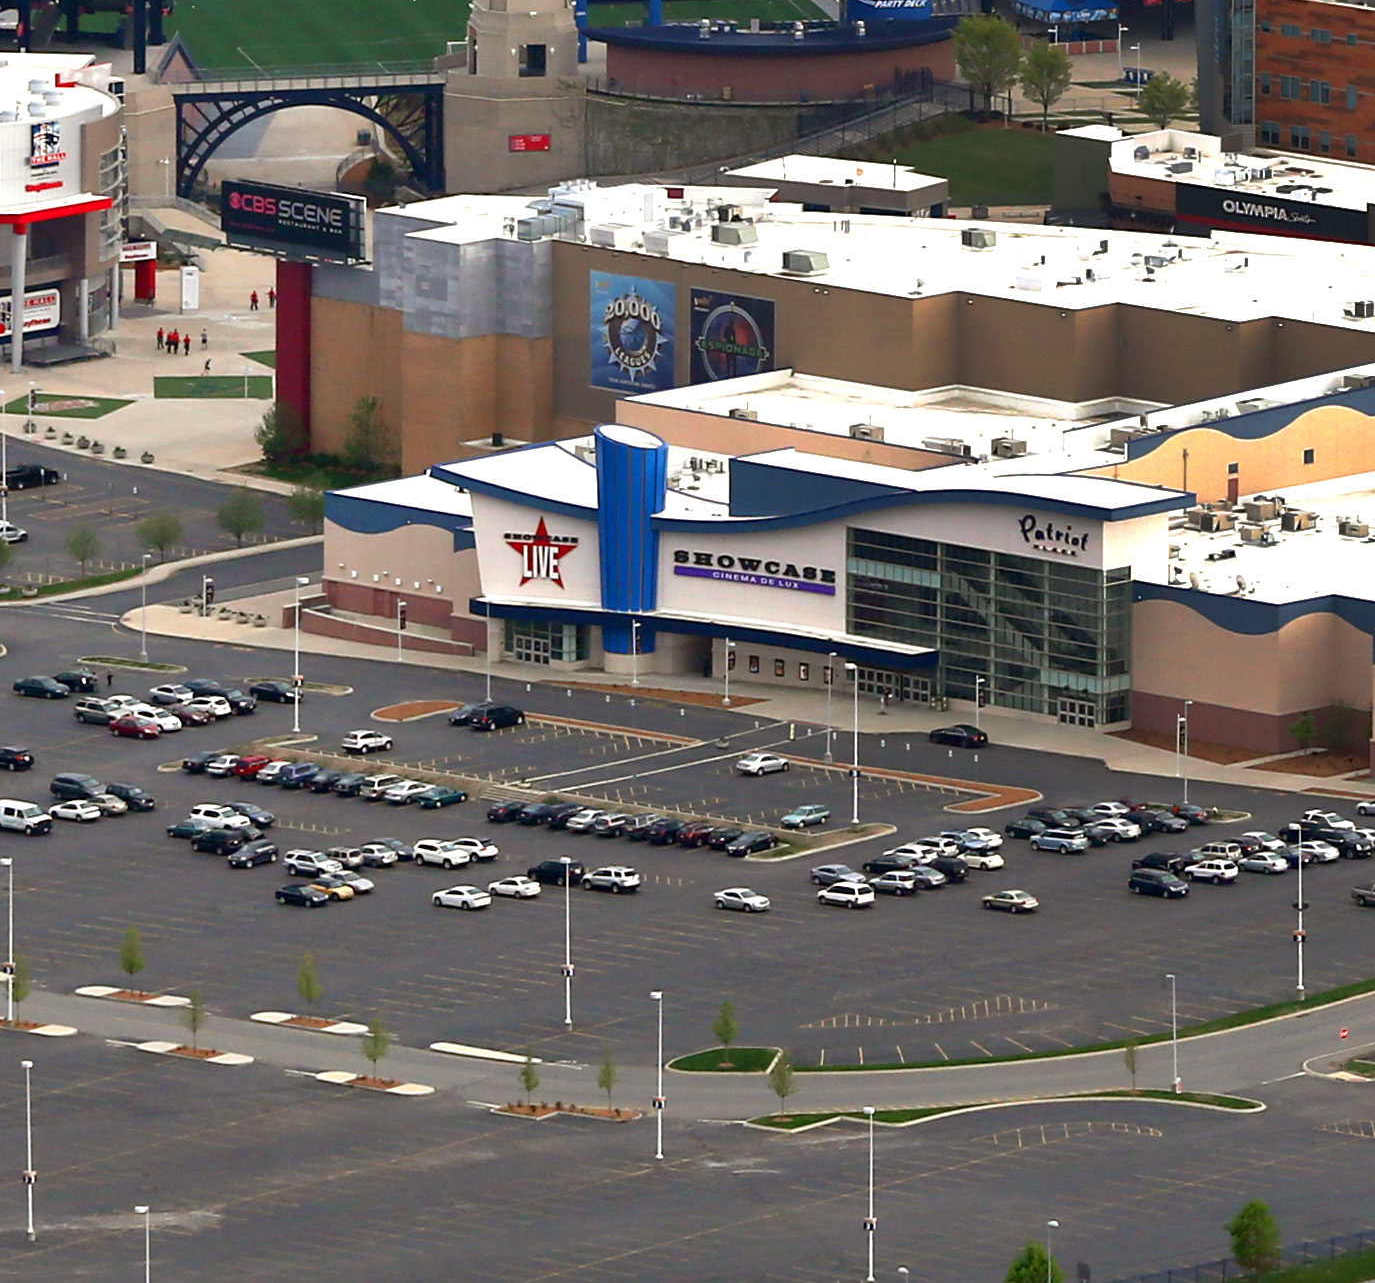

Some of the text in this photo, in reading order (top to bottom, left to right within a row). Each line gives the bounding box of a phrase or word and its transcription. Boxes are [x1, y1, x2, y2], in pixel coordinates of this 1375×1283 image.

[874, 0, 928, 9] PARTY DECK
[241, 195, 277, 215] CBS
[278, 200, 343, 227] SCENE
[1222, 199, 1288, 222] OLYMPIA
[278, 219, 320, 231] RESTAURANT
[605, 299, 661, 331] 20,000
[615, 347, 651, 368] LEAGUES
[701, 341, 764, 357] ESPIONAGE
[504, 533, 579, 543] SHOWCASE
[1018, 514, 1089, 551] Patriot
[523, 545, 559, 579] LIVE
[674, 550, 836, 583] SHOWCASE
[712, 571, 800, 589] CINEMA DE LUX
